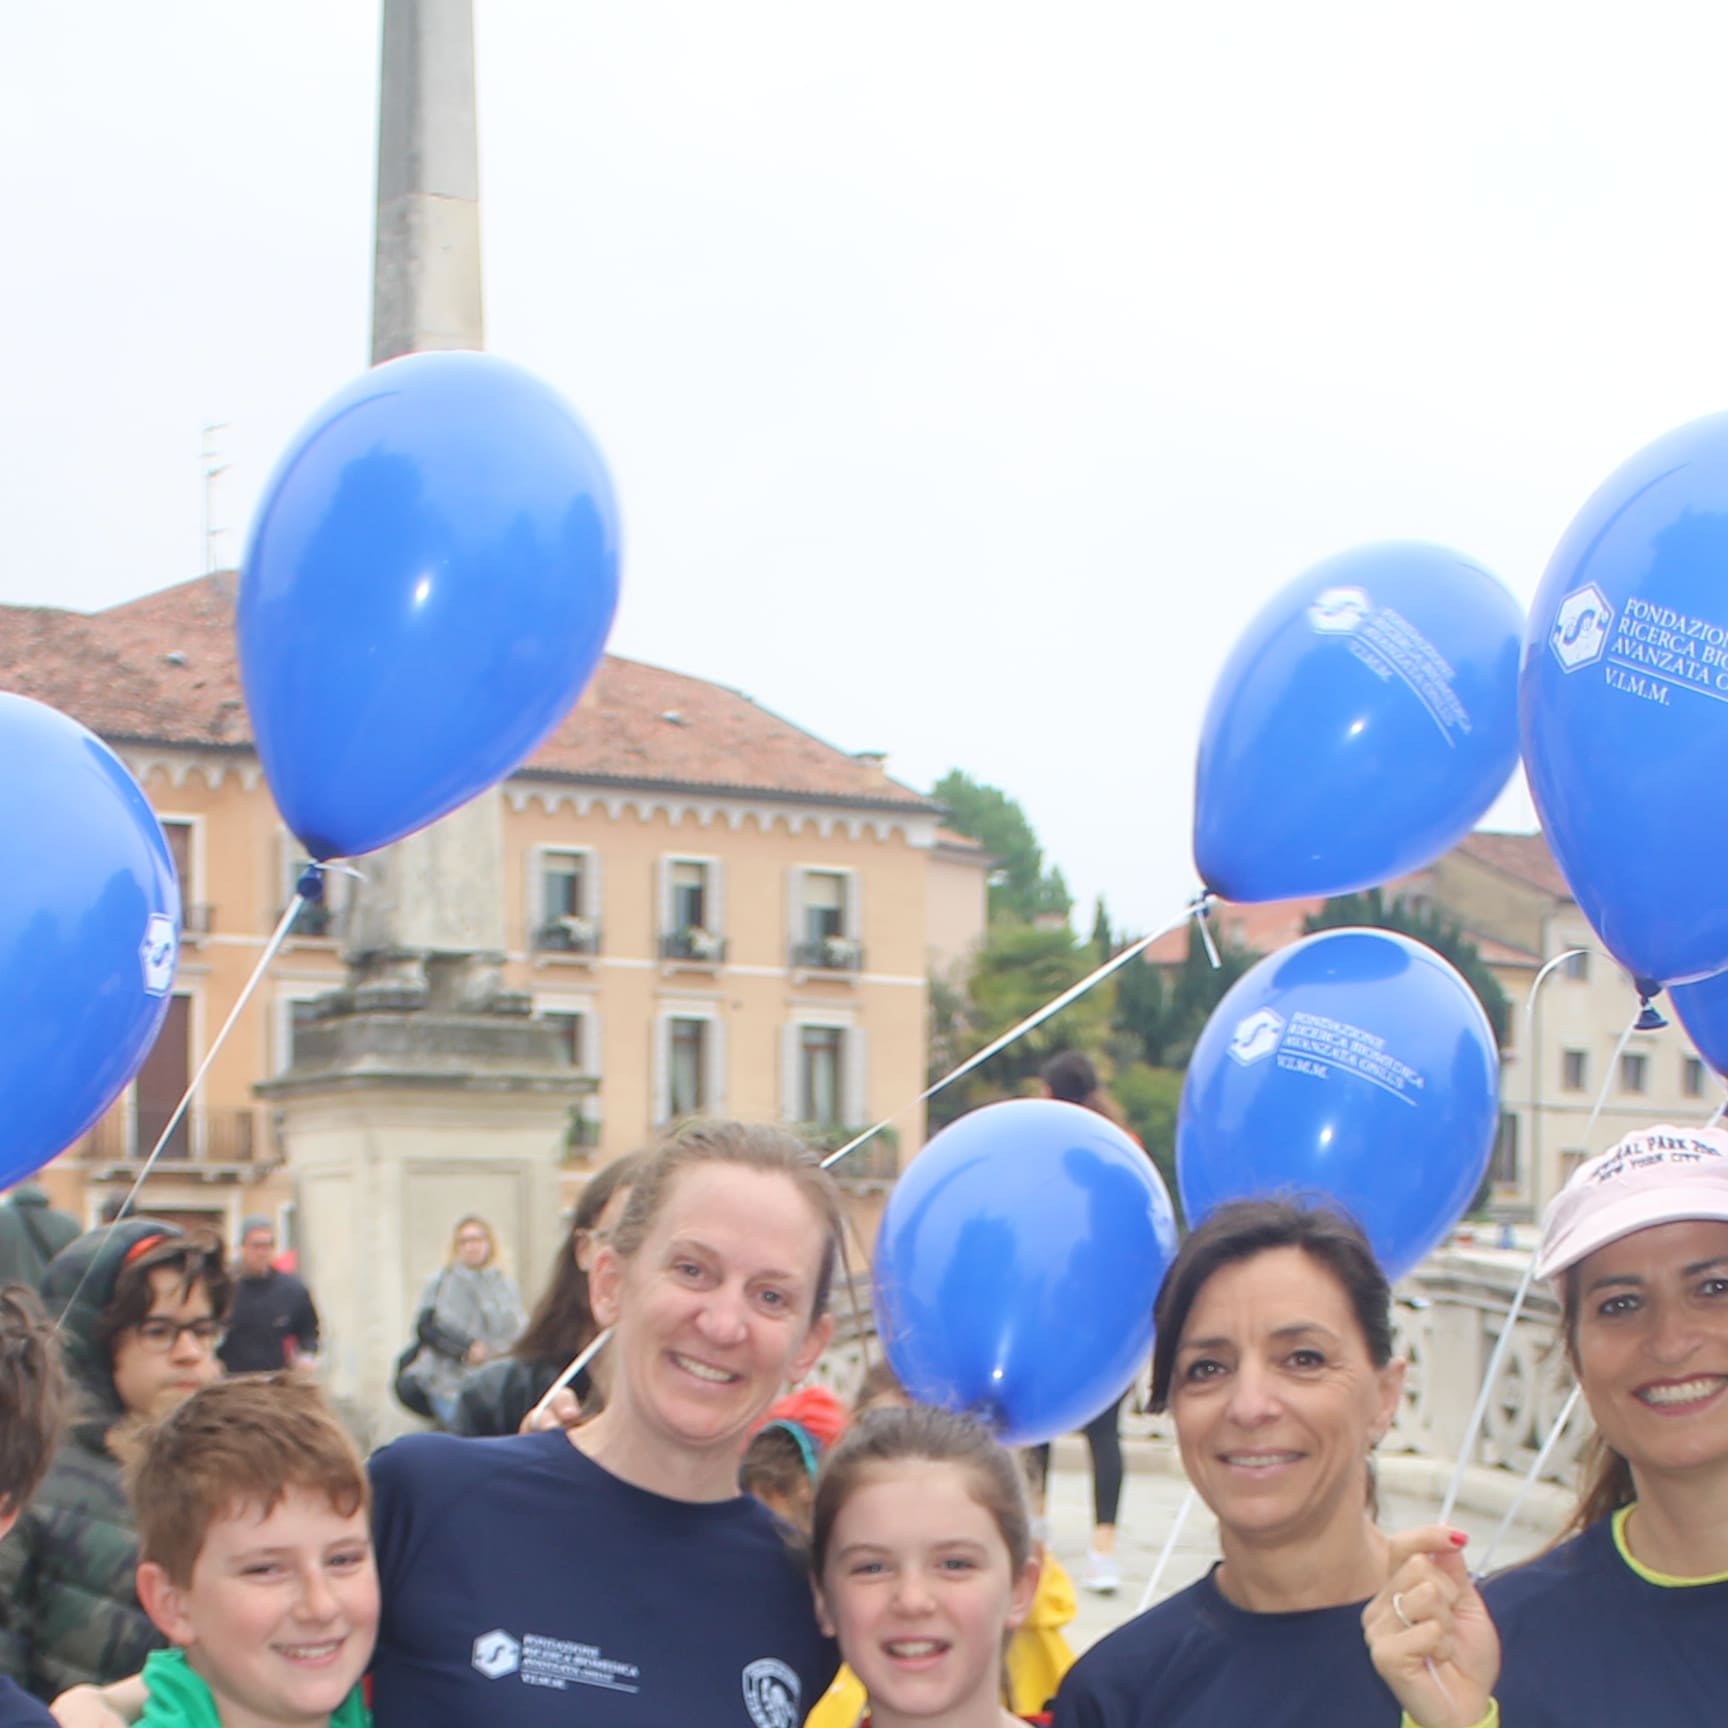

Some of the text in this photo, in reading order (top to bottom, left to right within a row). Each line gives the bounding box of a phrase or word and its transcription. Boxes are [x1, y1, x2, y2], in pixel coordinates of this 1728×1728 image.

[1618, 617, 1696, 659] RICERCA
[1611, 637, 1710, 685] AVANZATA
[1604, 666, 1670, 706] V.I.M.M.
